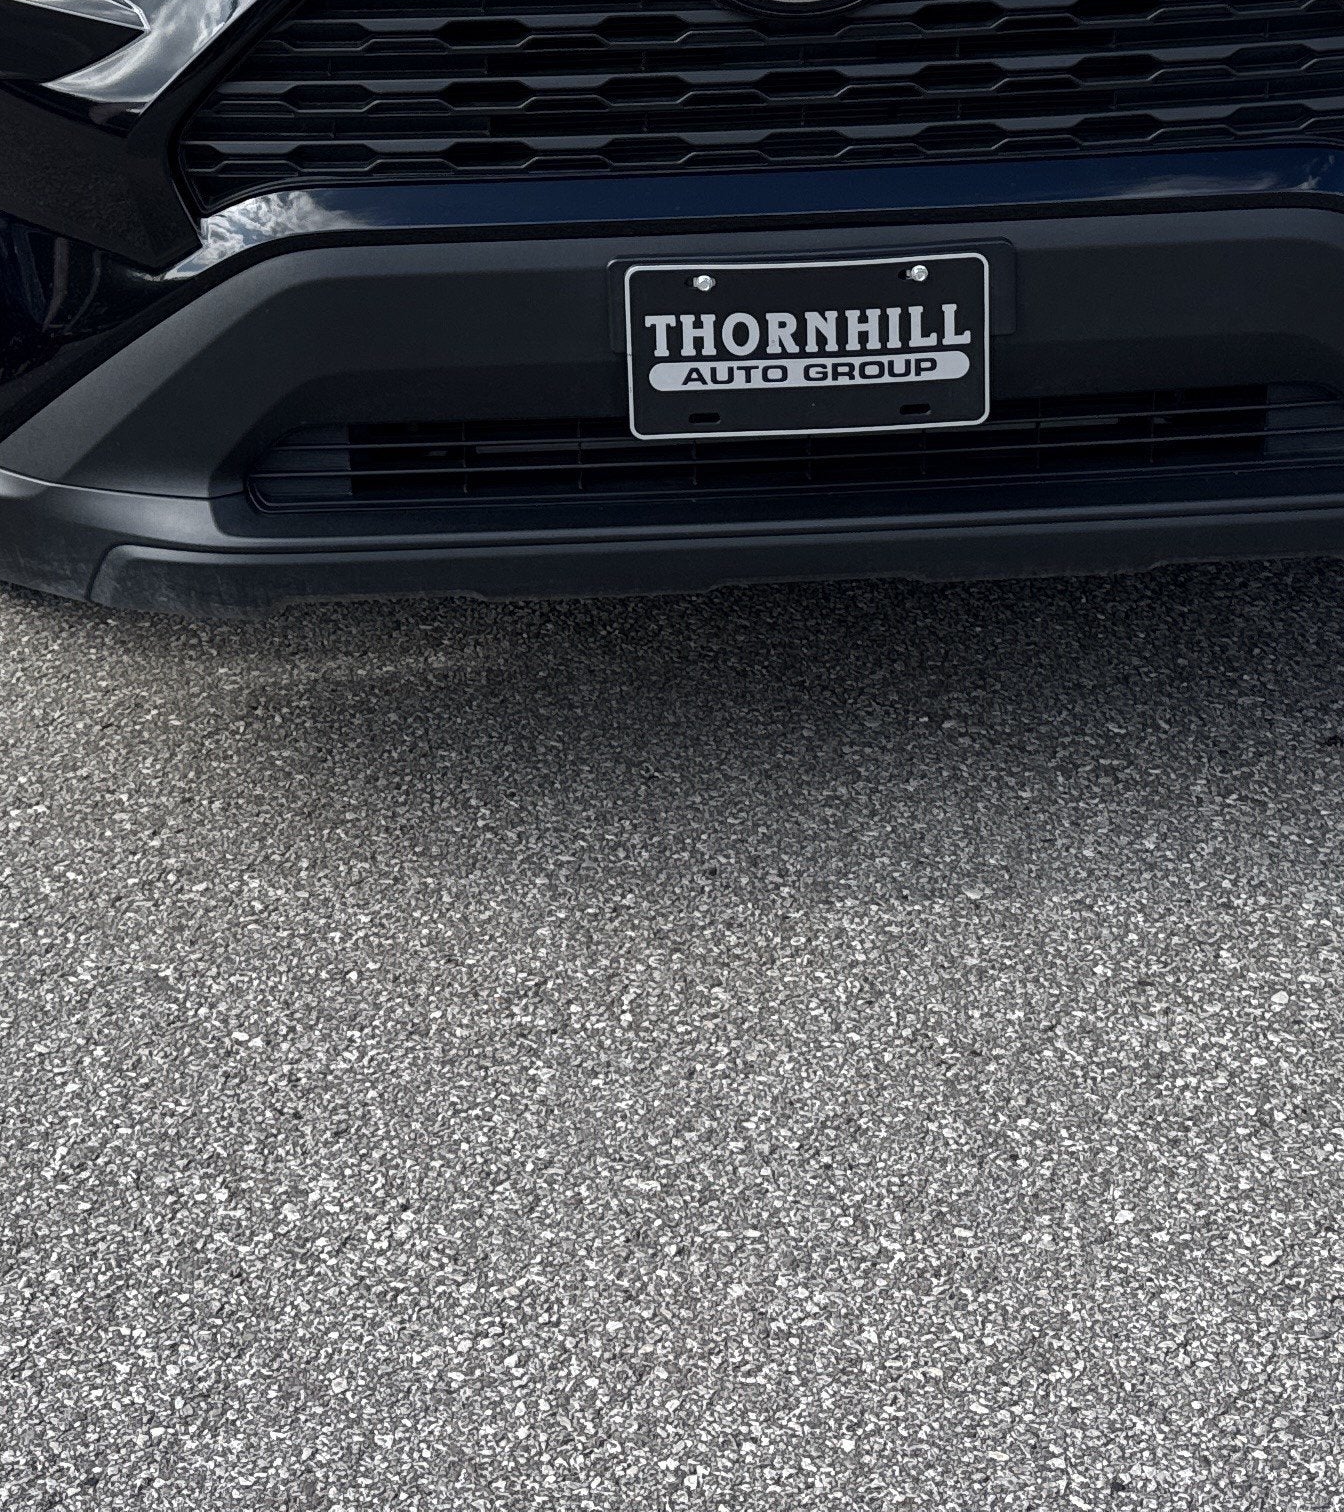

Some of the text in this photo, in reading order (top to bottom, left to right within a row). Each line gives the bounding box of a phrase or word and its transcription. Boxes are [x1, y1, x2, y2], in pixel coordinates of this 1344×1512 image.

[645, 303, 971, 357] THORNHILL
[682, 357, 937, 386] AUTO GROUP
